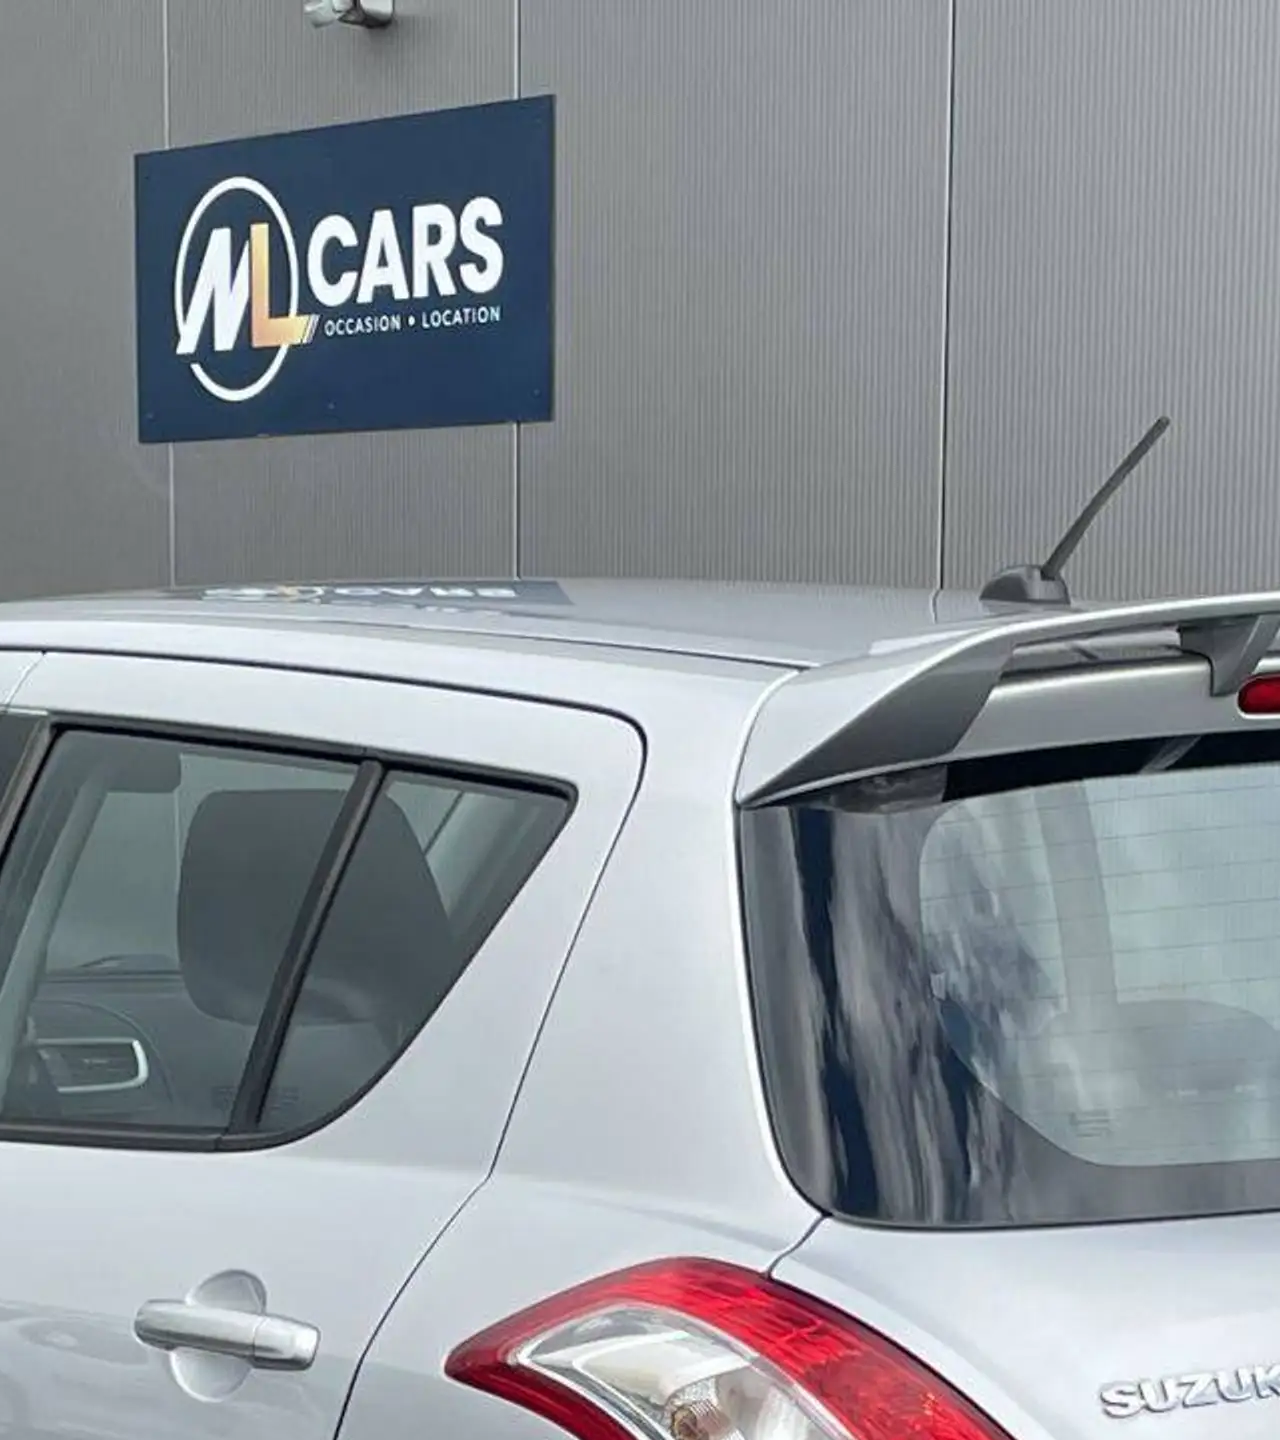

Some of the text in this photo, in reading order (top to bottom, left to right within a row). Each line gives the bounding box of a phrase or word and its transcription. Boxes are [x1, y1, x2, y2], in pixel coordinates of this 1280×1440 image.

[175, 196, 504, 355] ML CARS
[324, 305, 501, 338] OCCASION LOCATION
